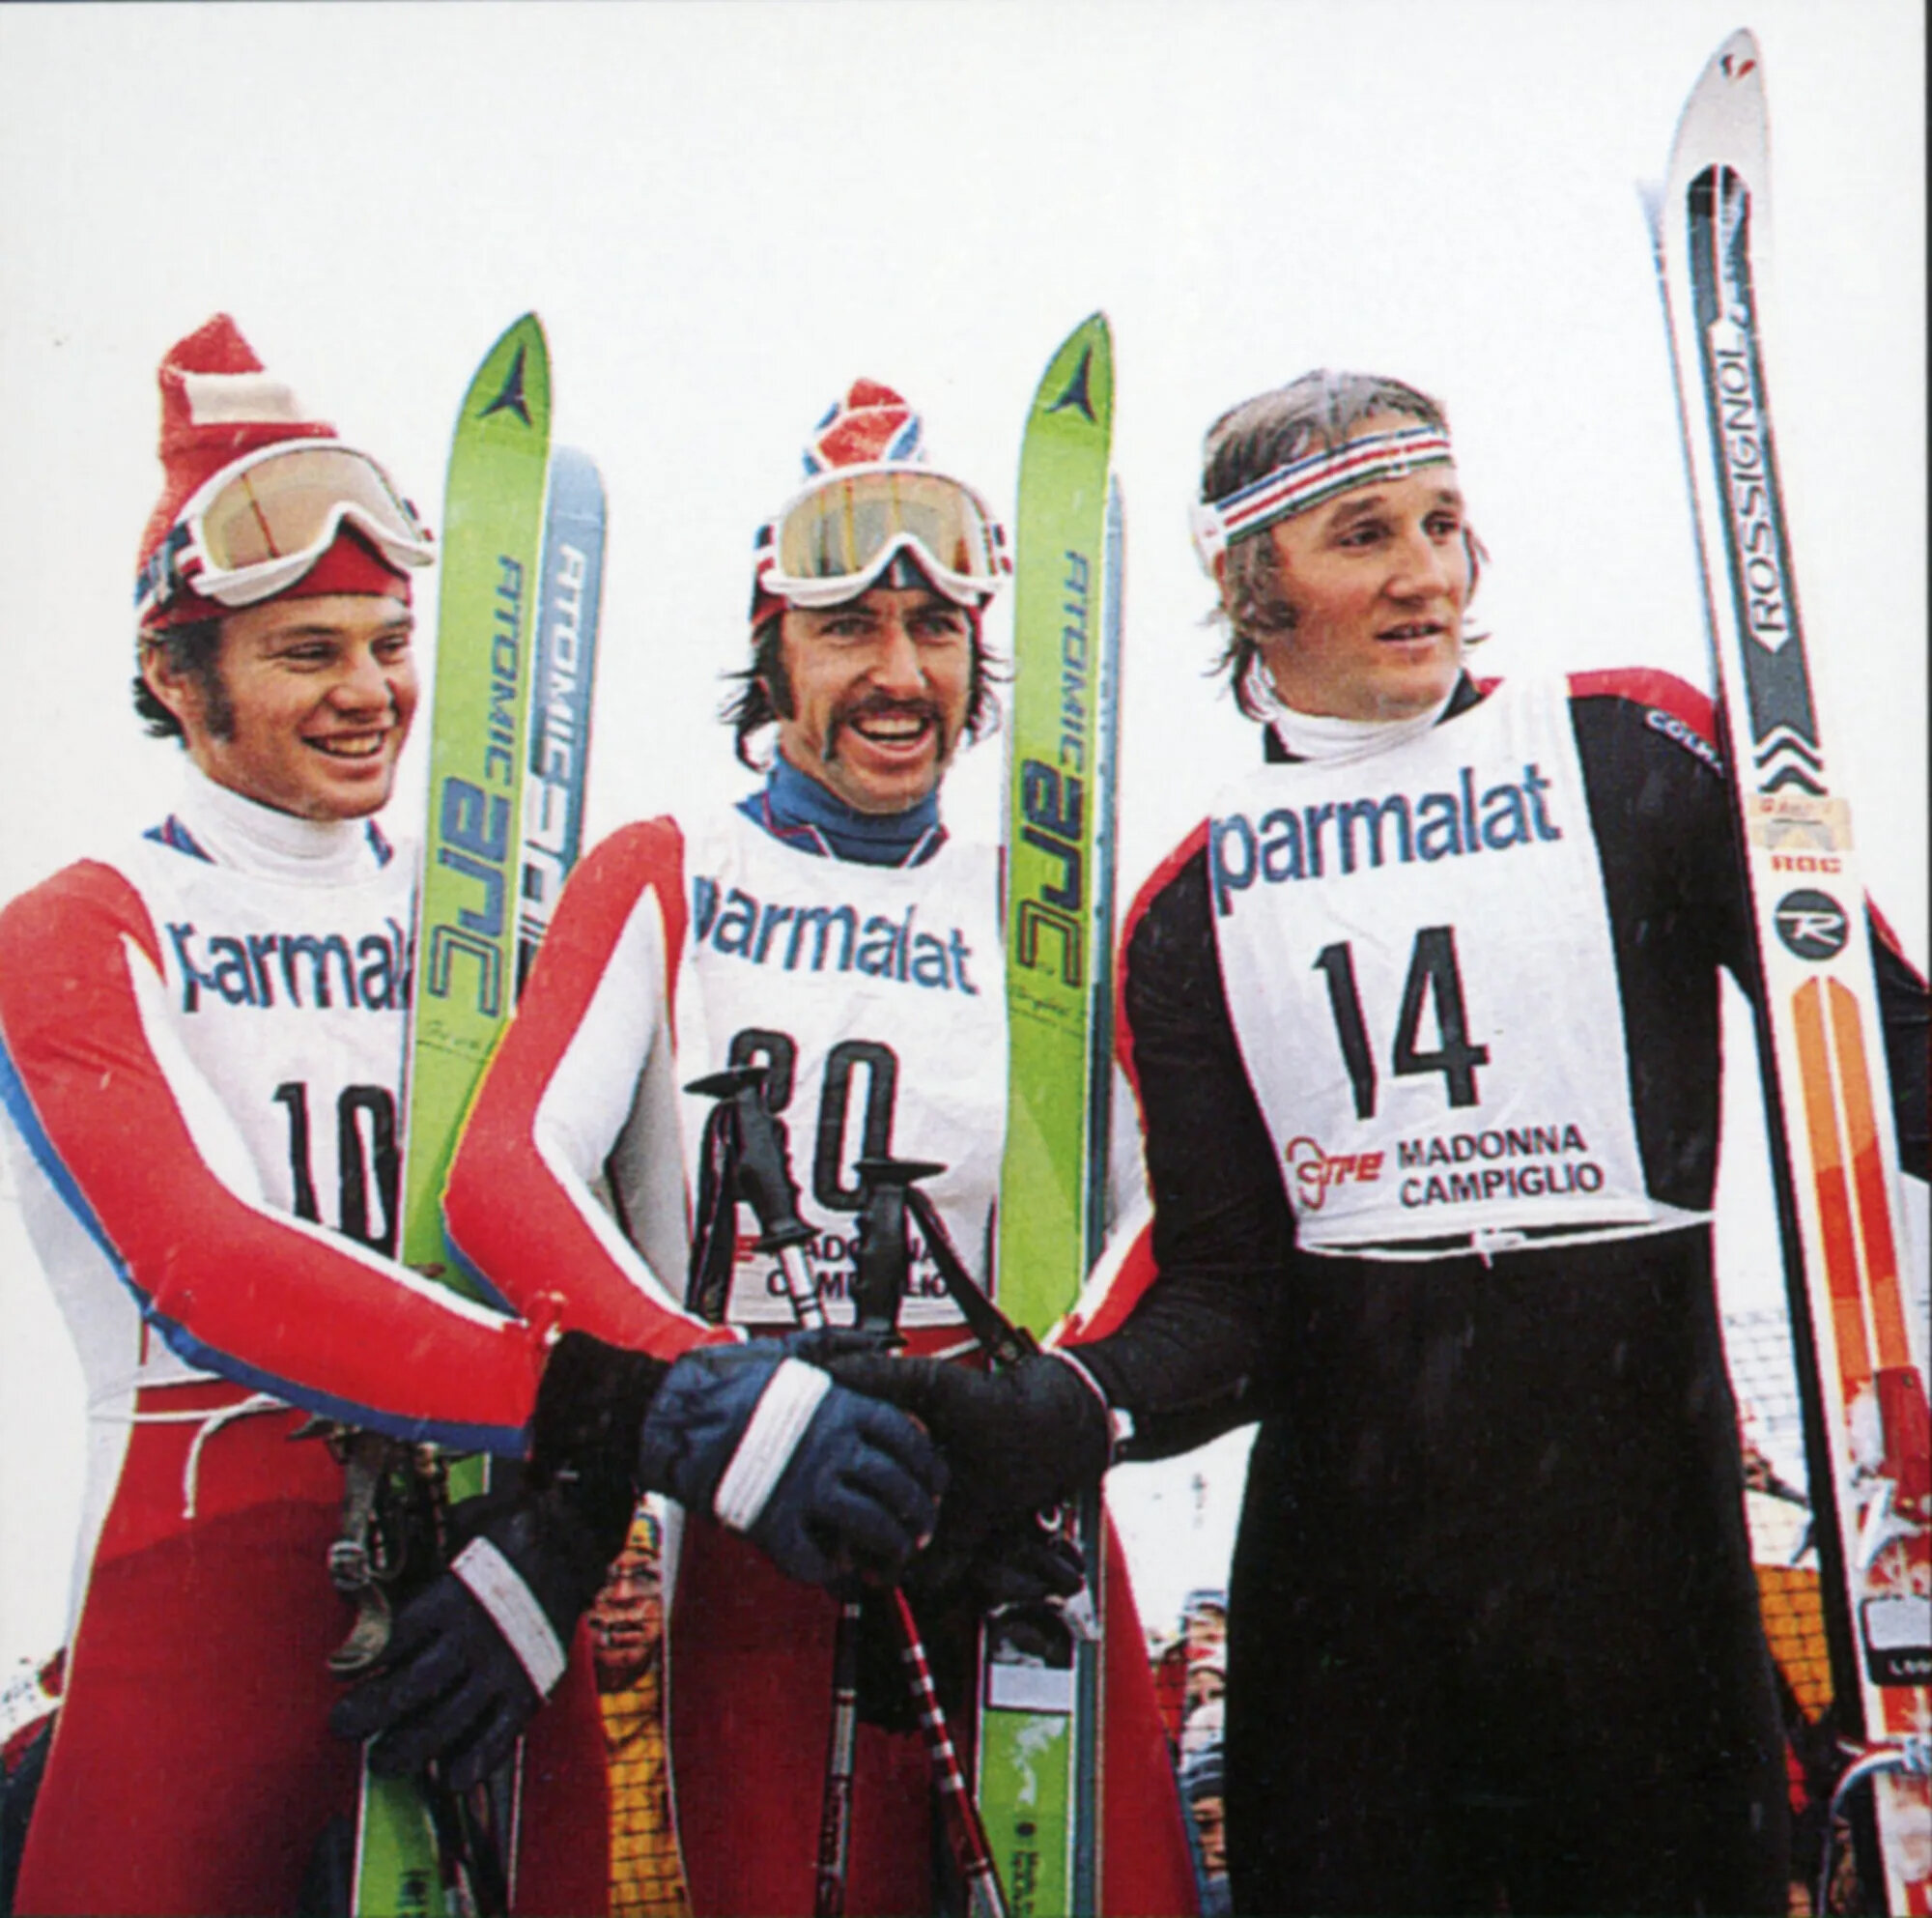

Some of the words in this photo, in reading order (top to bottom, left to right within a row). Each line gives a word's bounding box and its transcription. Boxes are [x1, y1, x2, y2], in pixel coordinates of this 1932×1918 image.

[1716, 334, 1787, 633] ROSSIGNOL
[484, 554, 525, 787] ATOMIC
[540, 543, 587, 784] ATOMIC
[1059, 550, 1091, 773] ATOMIC
[1208, 763, 1563, 917] parmalat
[1312, 925, 1491, 1121] 14
[273, 1080, 401, 1262] 10
[1397, 1123, 1588, 1170] MADONNA
[1399, 1161, 1605, 1209] CAMPIGLIO
